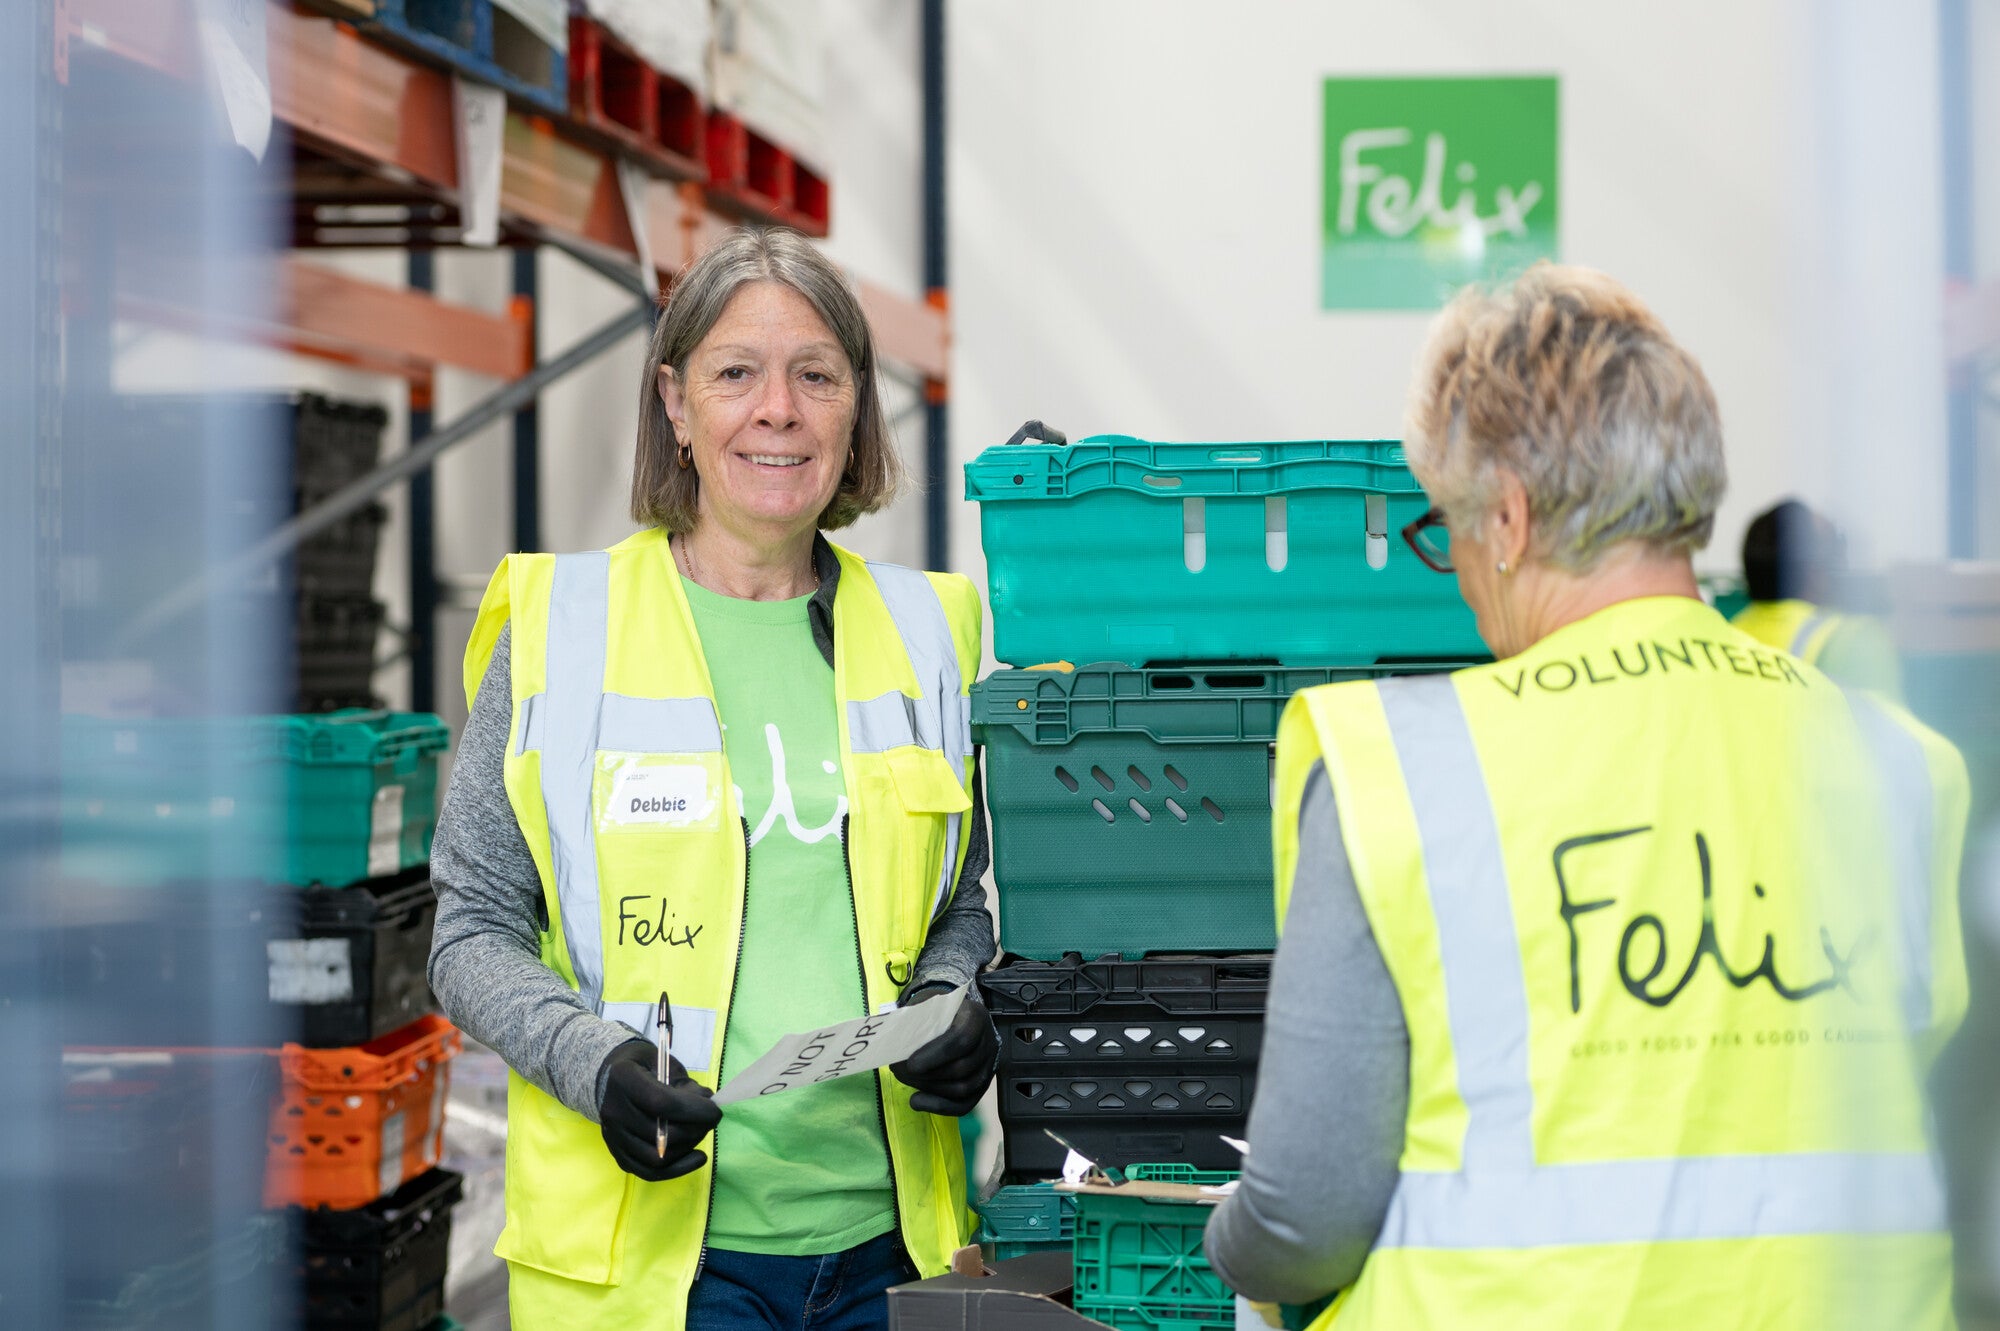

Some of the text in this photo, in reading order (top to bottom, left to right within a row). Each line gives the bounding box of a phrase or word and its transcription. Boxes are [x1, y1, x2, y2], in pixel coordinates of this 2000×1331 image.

[1337, 126, 1543, 238] Felix
[1493, 638, 1809, 698] VOLUNTEER
[630, 796, 687, 813] Debbie
[619, 895, 703, 949] Felix
[1553, 824, 1882, 1015] Felix
[759, 1031, 836, 1095] O NOT
